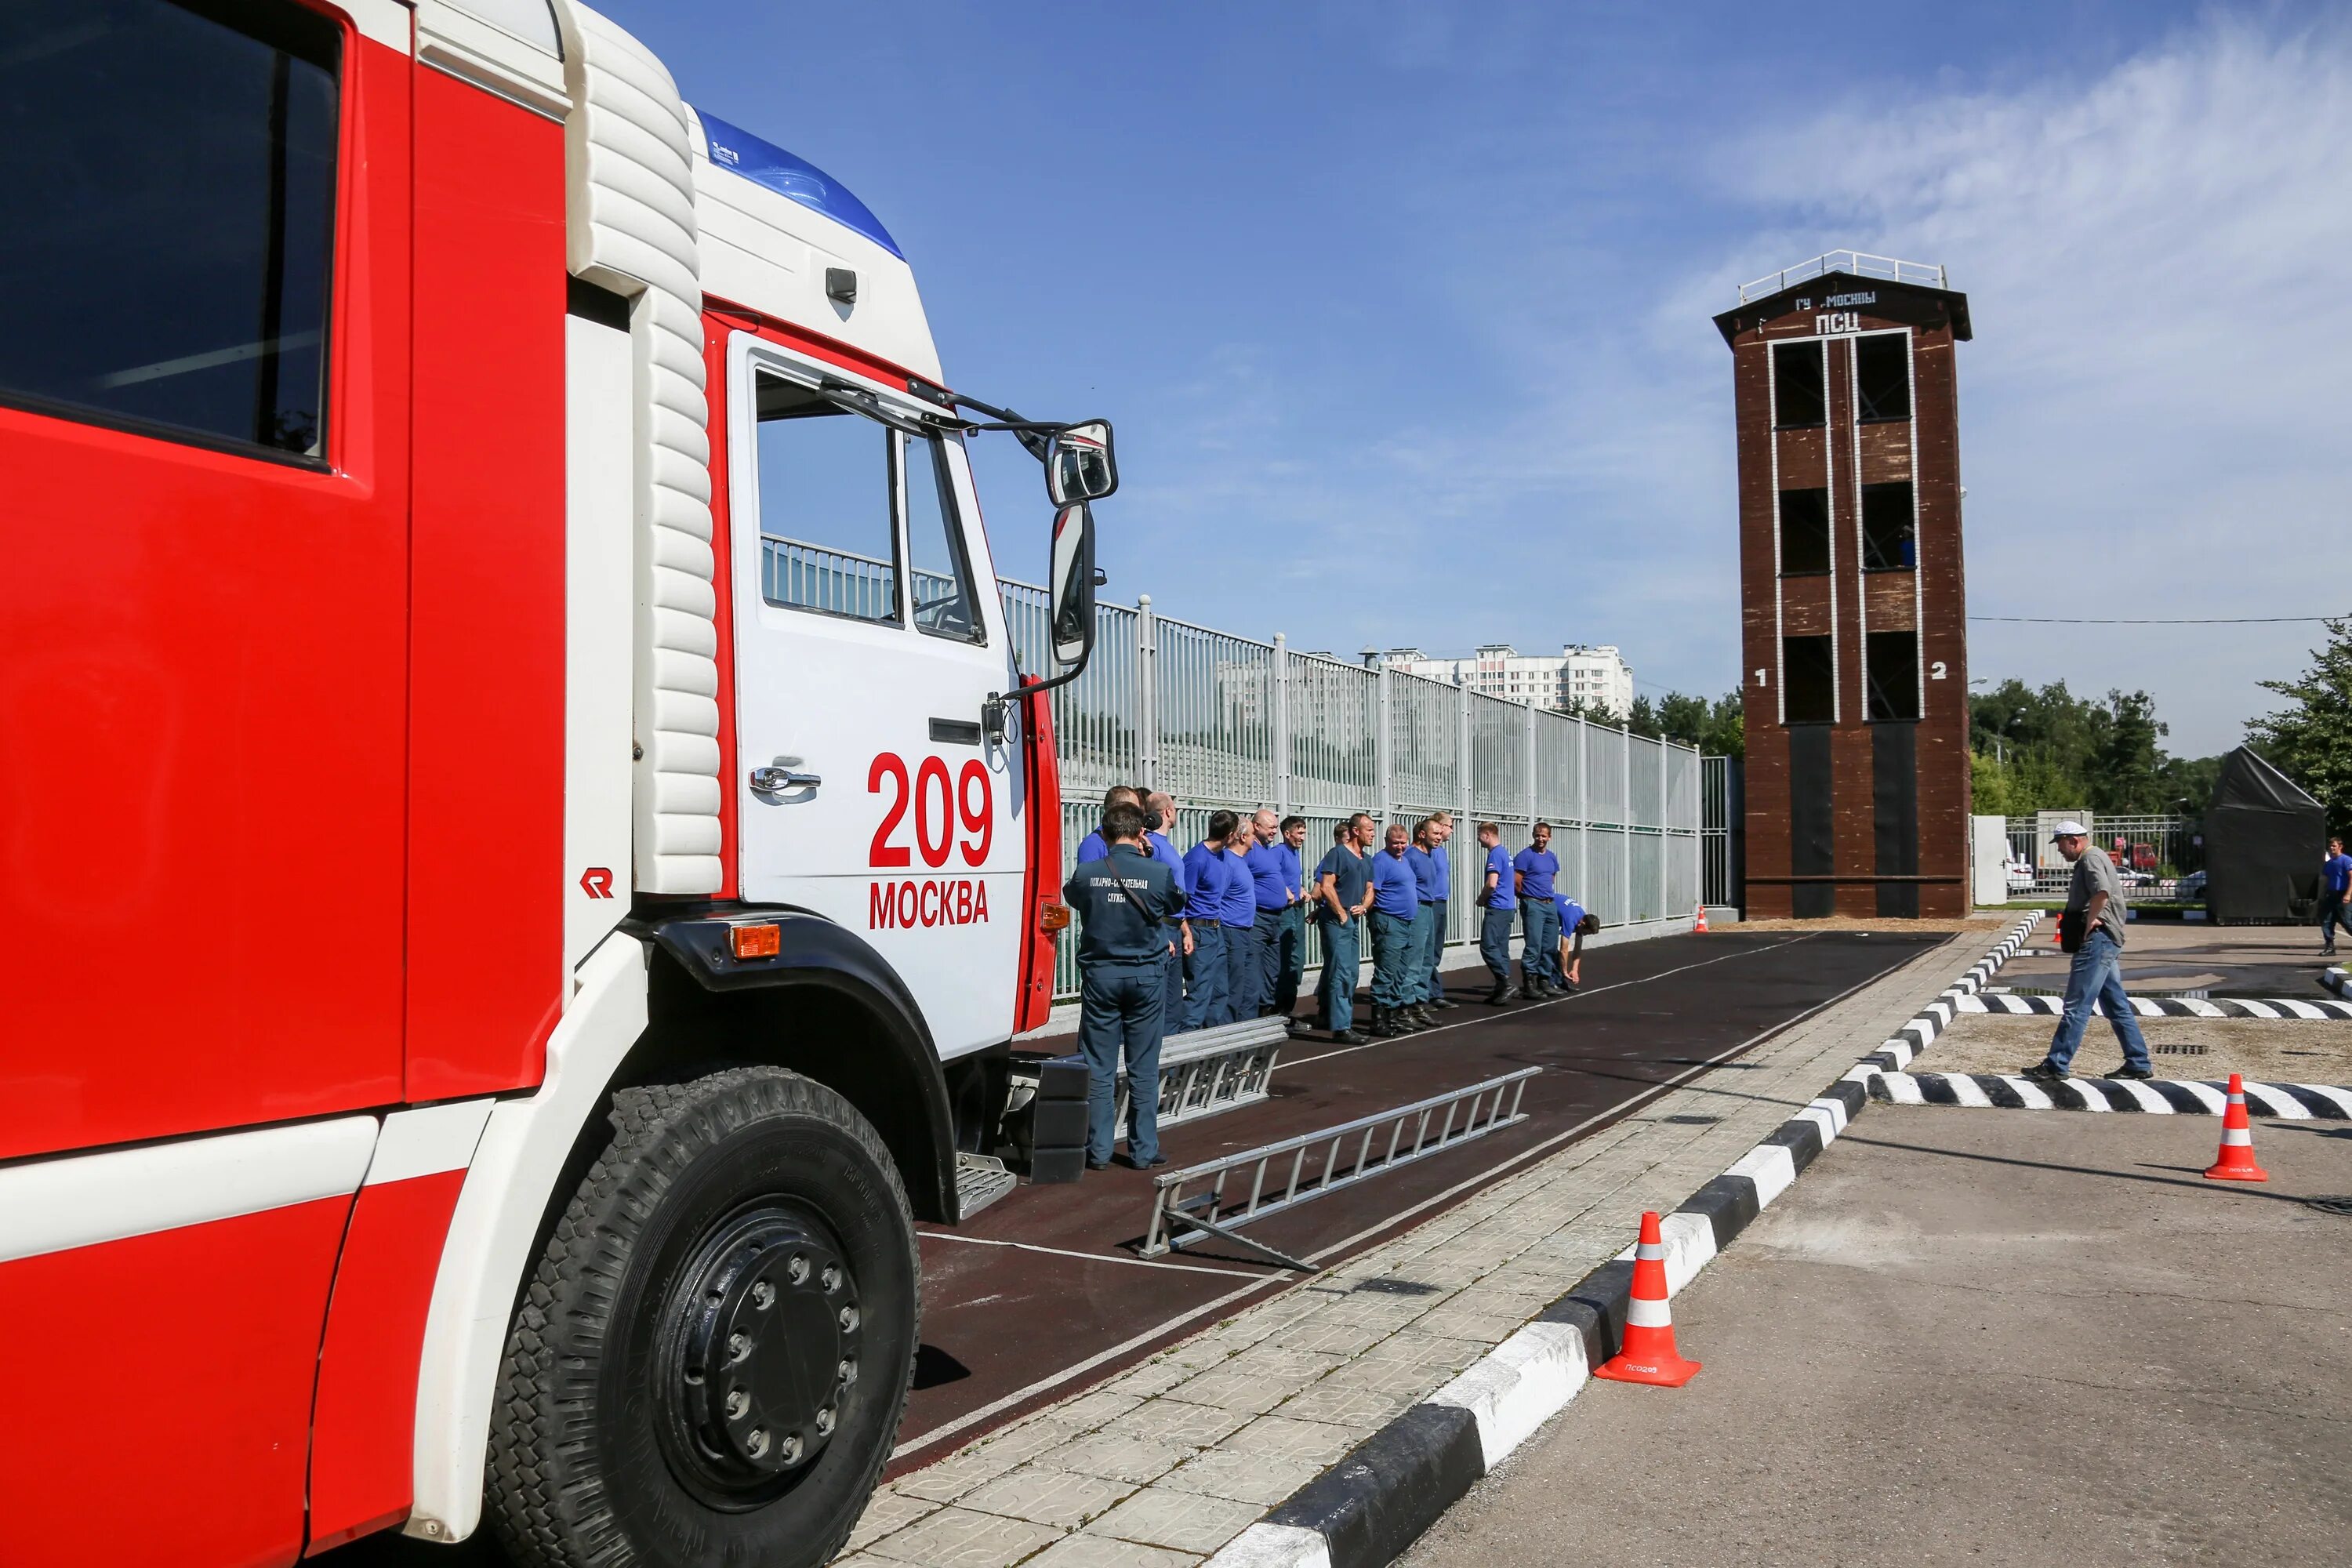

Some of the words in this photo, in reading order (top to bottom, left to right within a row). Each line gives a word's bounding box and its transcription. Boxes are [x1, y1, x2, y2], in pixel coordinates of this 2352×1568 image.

[1816, 312, 1861, 334] ПСЦ
[1755, 668, 1766, 687] 1
[1931, 661, 1947, 680] 2
[867, 751, 993, 868] 209
[1090, 877, 1149, 889] ПОЖАРНО-ССАТЕЛЬНАЯ
[869, 880, 989, 931] МОСКВА
